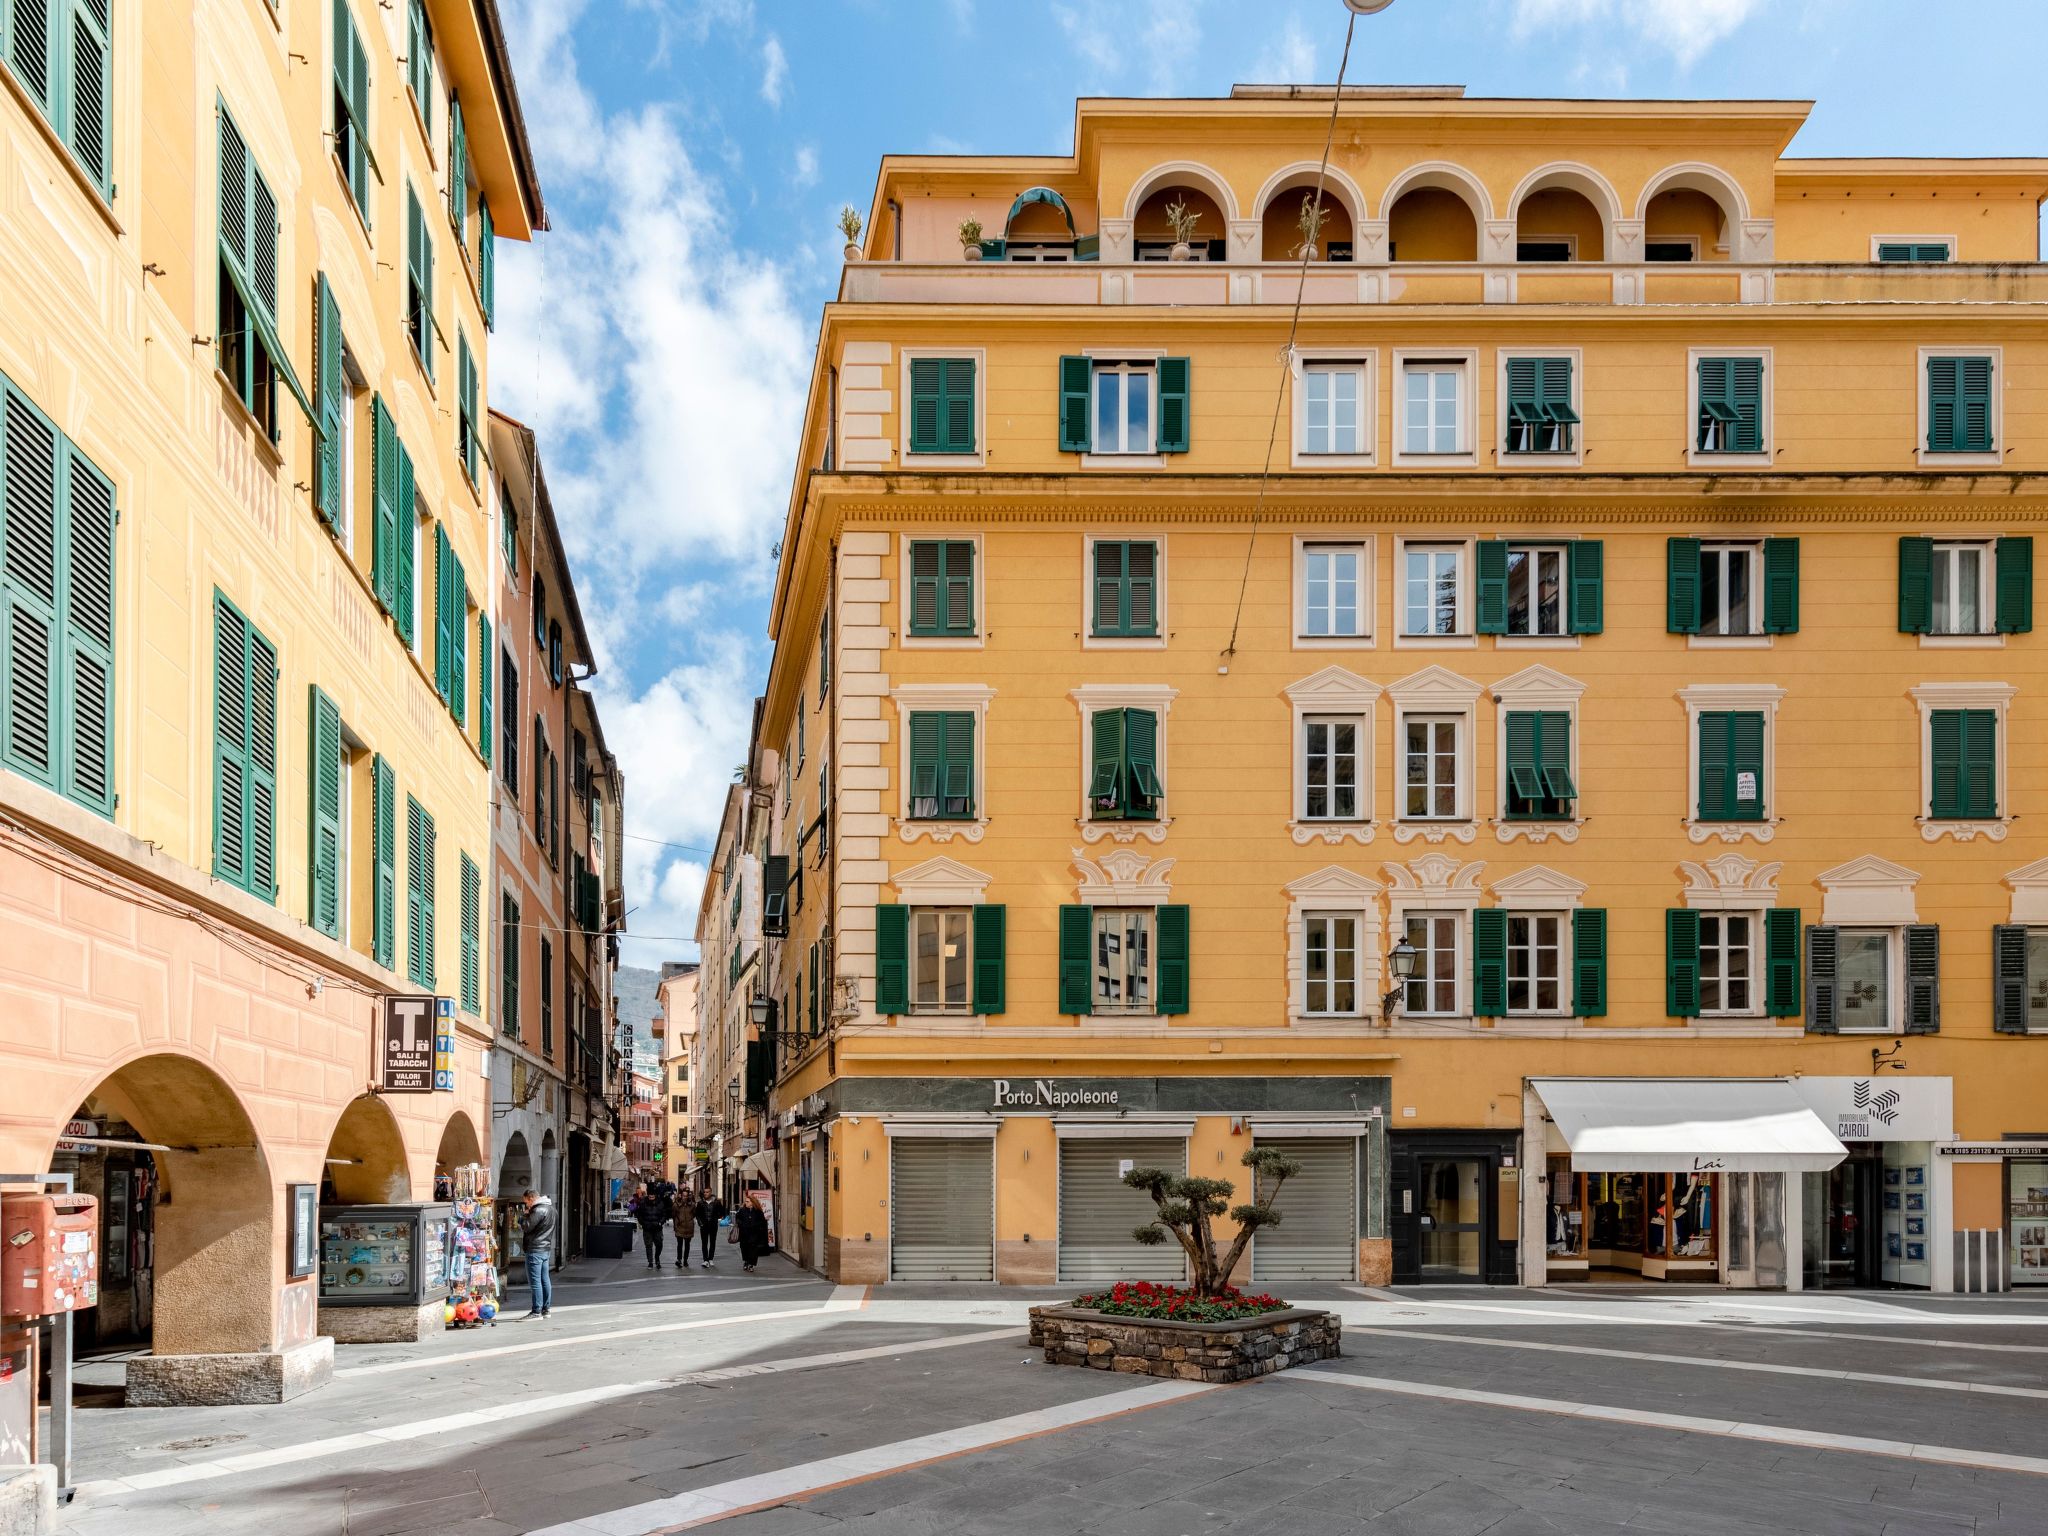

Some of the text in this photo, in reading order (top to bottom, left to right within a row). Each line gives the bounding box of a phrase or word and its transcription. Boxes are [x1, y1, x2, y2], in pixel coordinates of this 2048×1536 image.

[395, 1002, 425, 1051] T
[437, 1002, 449, 1086] LOTTO
[624, 1025, 633, 1106] GRAGLIA
[993, 1080, 1118, 1107] Porto Napoleone
[1838, 1113, 1869, 1122] IMMOBILIARE
[1838, 1123, 1869, 1138] CAIROLI
[1693, 1156, 1726, 1171] Lai
